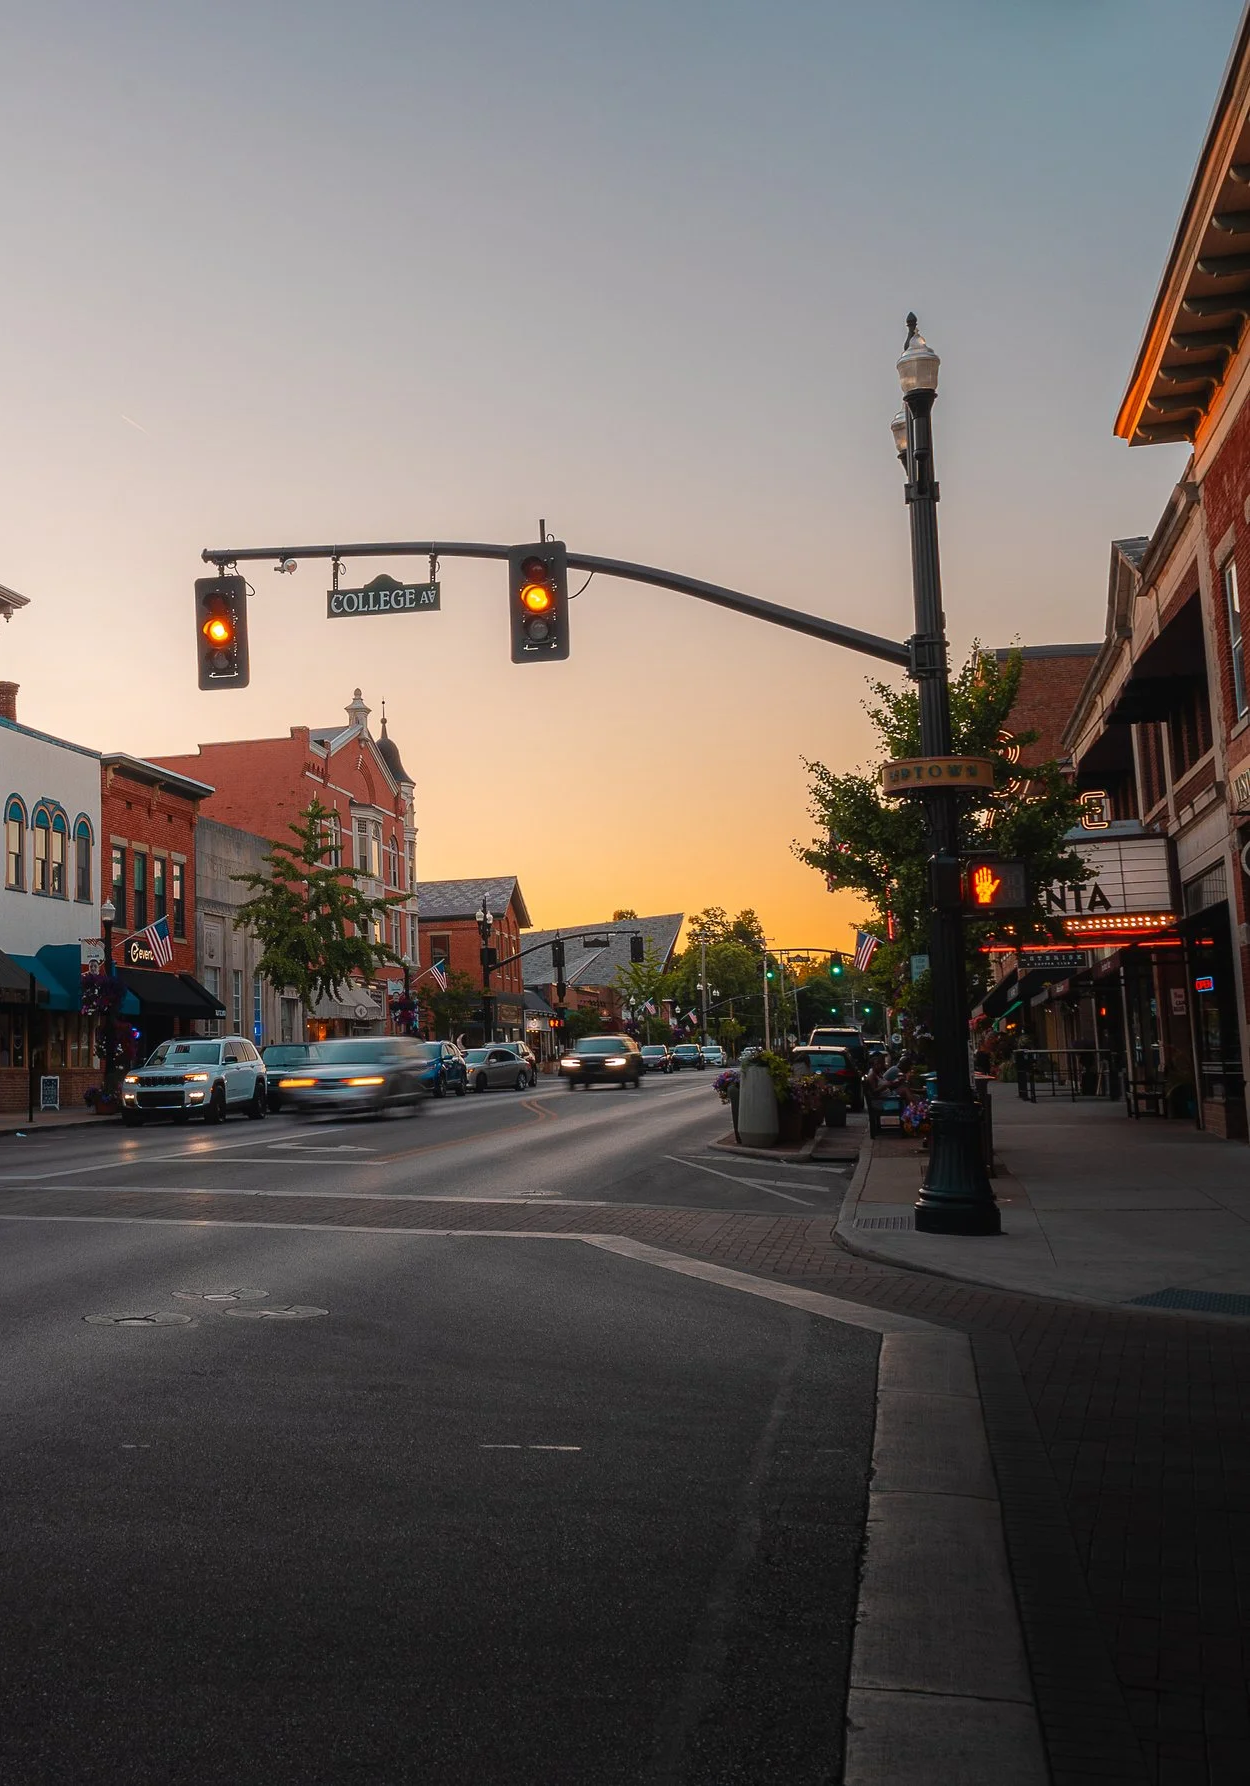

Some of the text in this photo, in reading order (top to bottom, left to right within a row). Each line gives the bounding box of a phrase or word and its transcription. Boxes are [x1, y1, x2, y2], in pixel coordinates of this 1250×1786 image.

[331, 589, 416, 613] COLLEGE
[1046, 882, 1112, 914] NTA
[1196, 978, 1212, 991] OPEN
